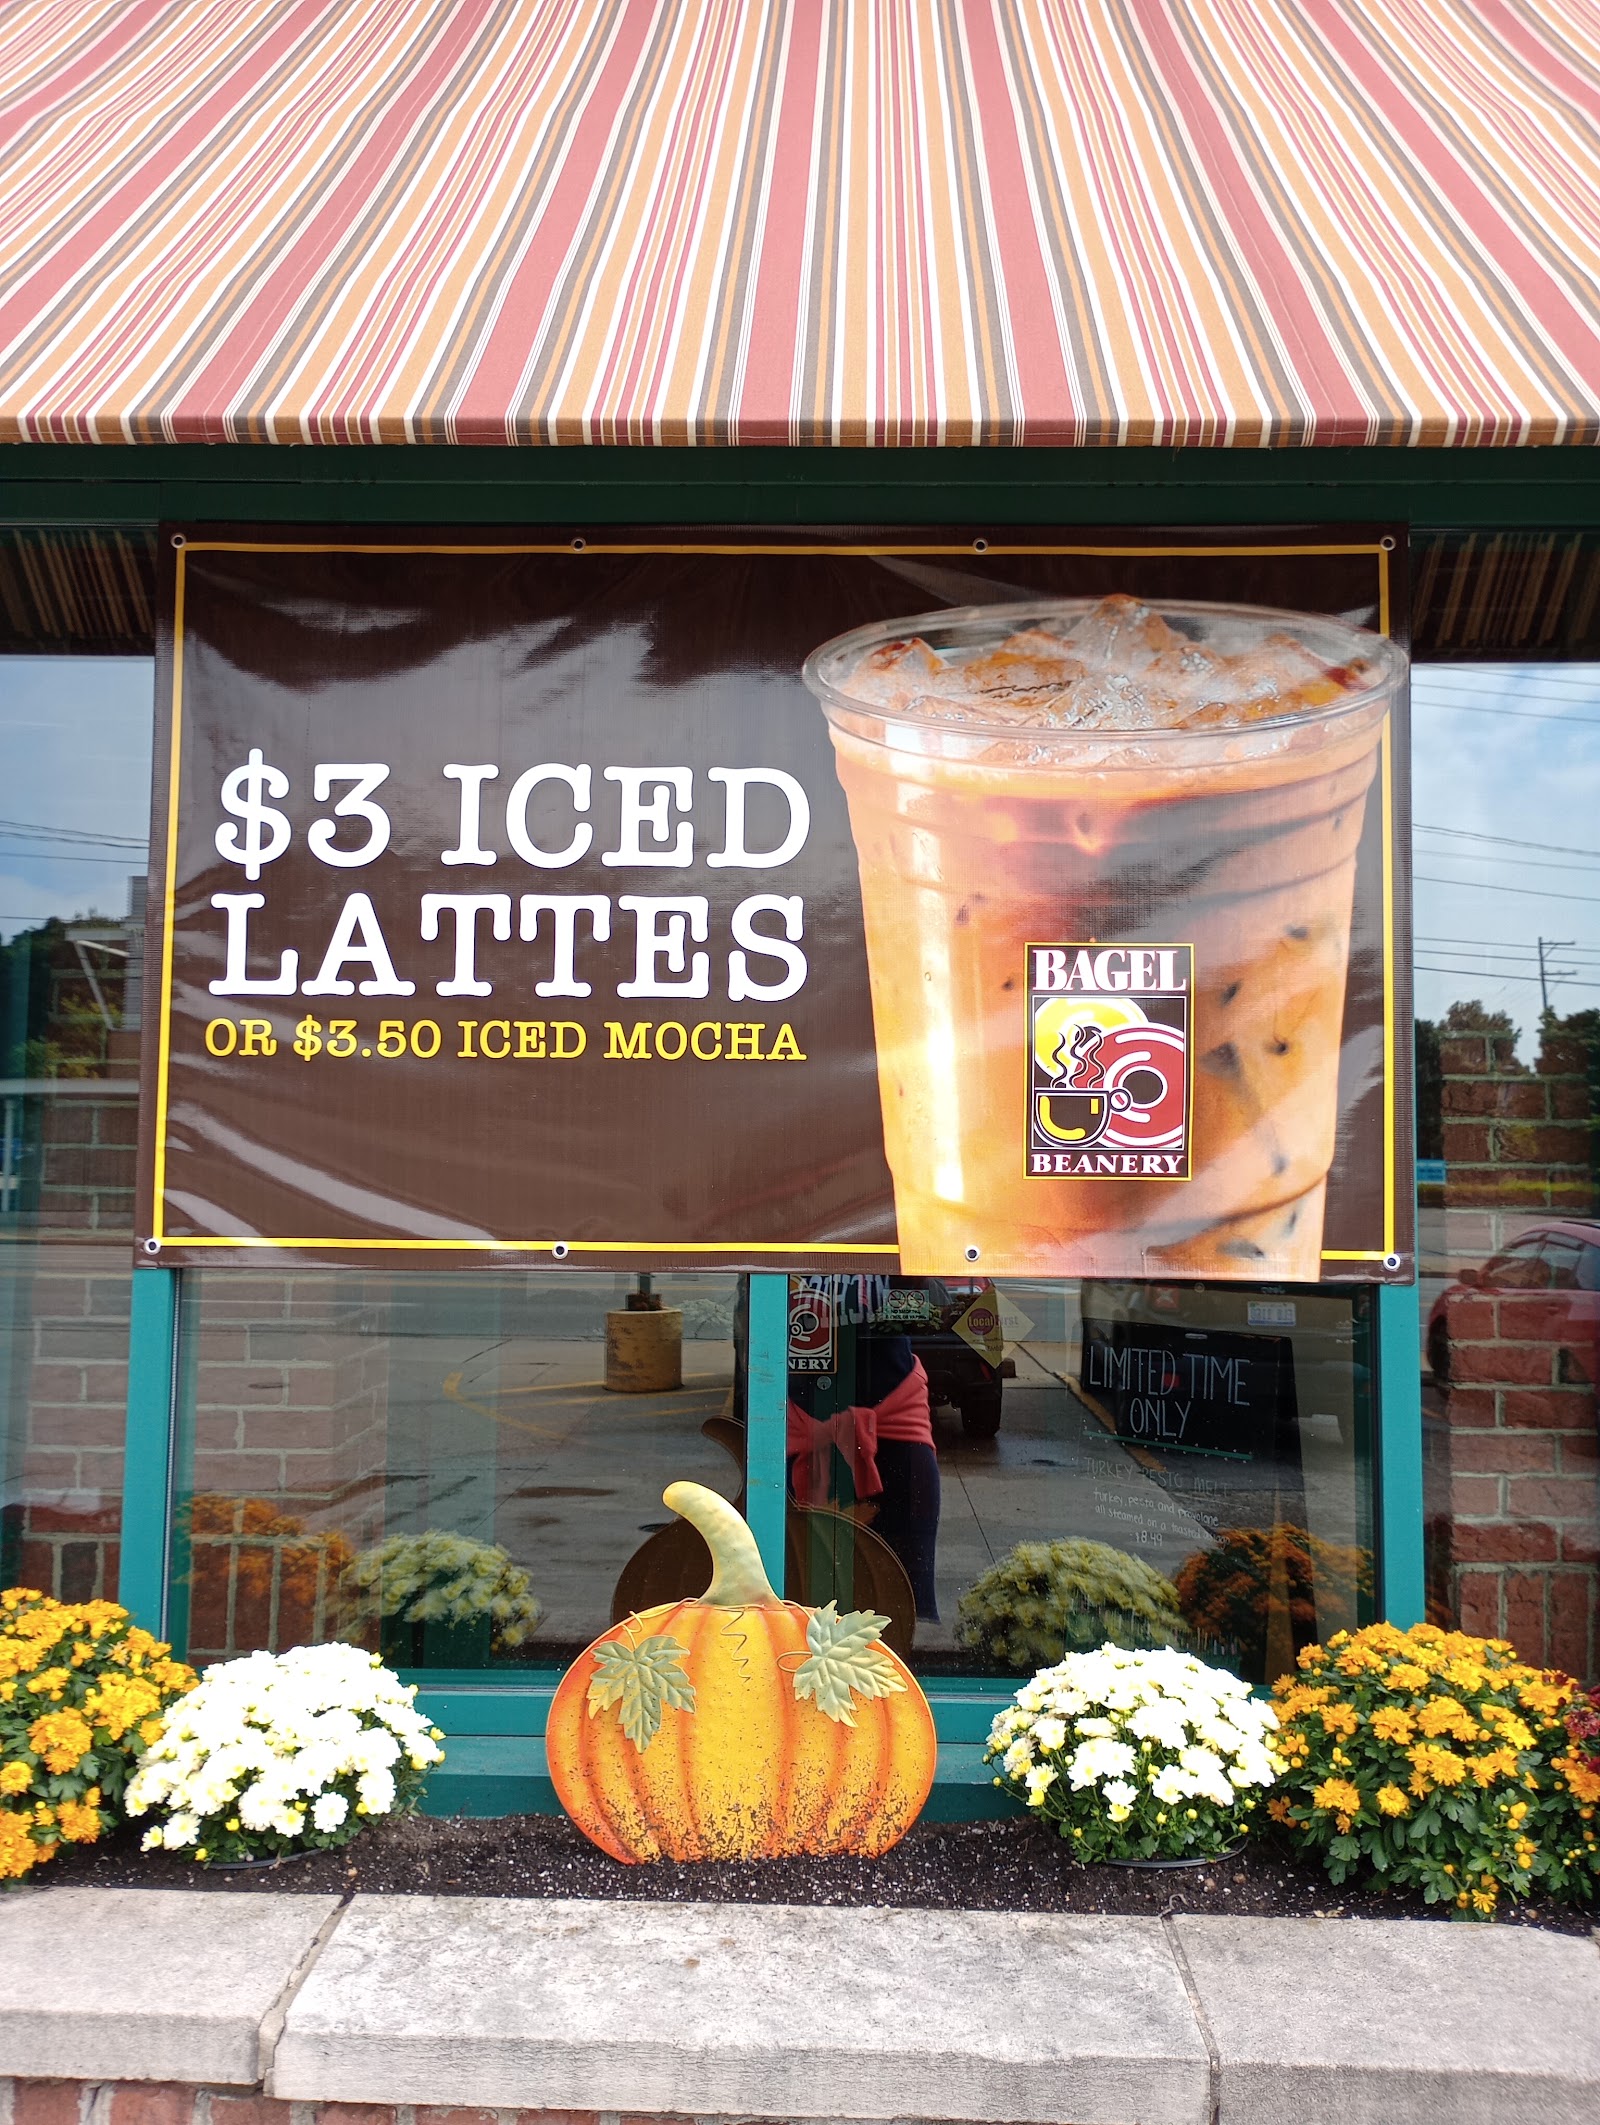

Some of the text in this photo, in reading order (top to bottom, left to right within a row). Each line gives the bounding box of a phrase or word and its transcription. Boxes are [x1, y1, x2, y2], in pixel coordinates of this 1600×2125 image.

[213, 748, 812, 881] $3 ICED
[208, 892, 810, 1002] LATTES
[1032, 949, 1187, 992] BAGEL
[204, 1014, 807, 1062] OR $3.50 ICED MOCHA
[1031, 1153, 1185, 1174] BEANERY
[968, 1315, 994, 1327] Local
[1089, 1345, 1250, 1406] LIMITED TIME
[1130, 1397, 1191, 1438] ONLY
[1084, 1457, 1134, 1481] TURKEY
[1147, 1516, 1158, 1528] on
[1157, 1500, 1175, 1514] and
